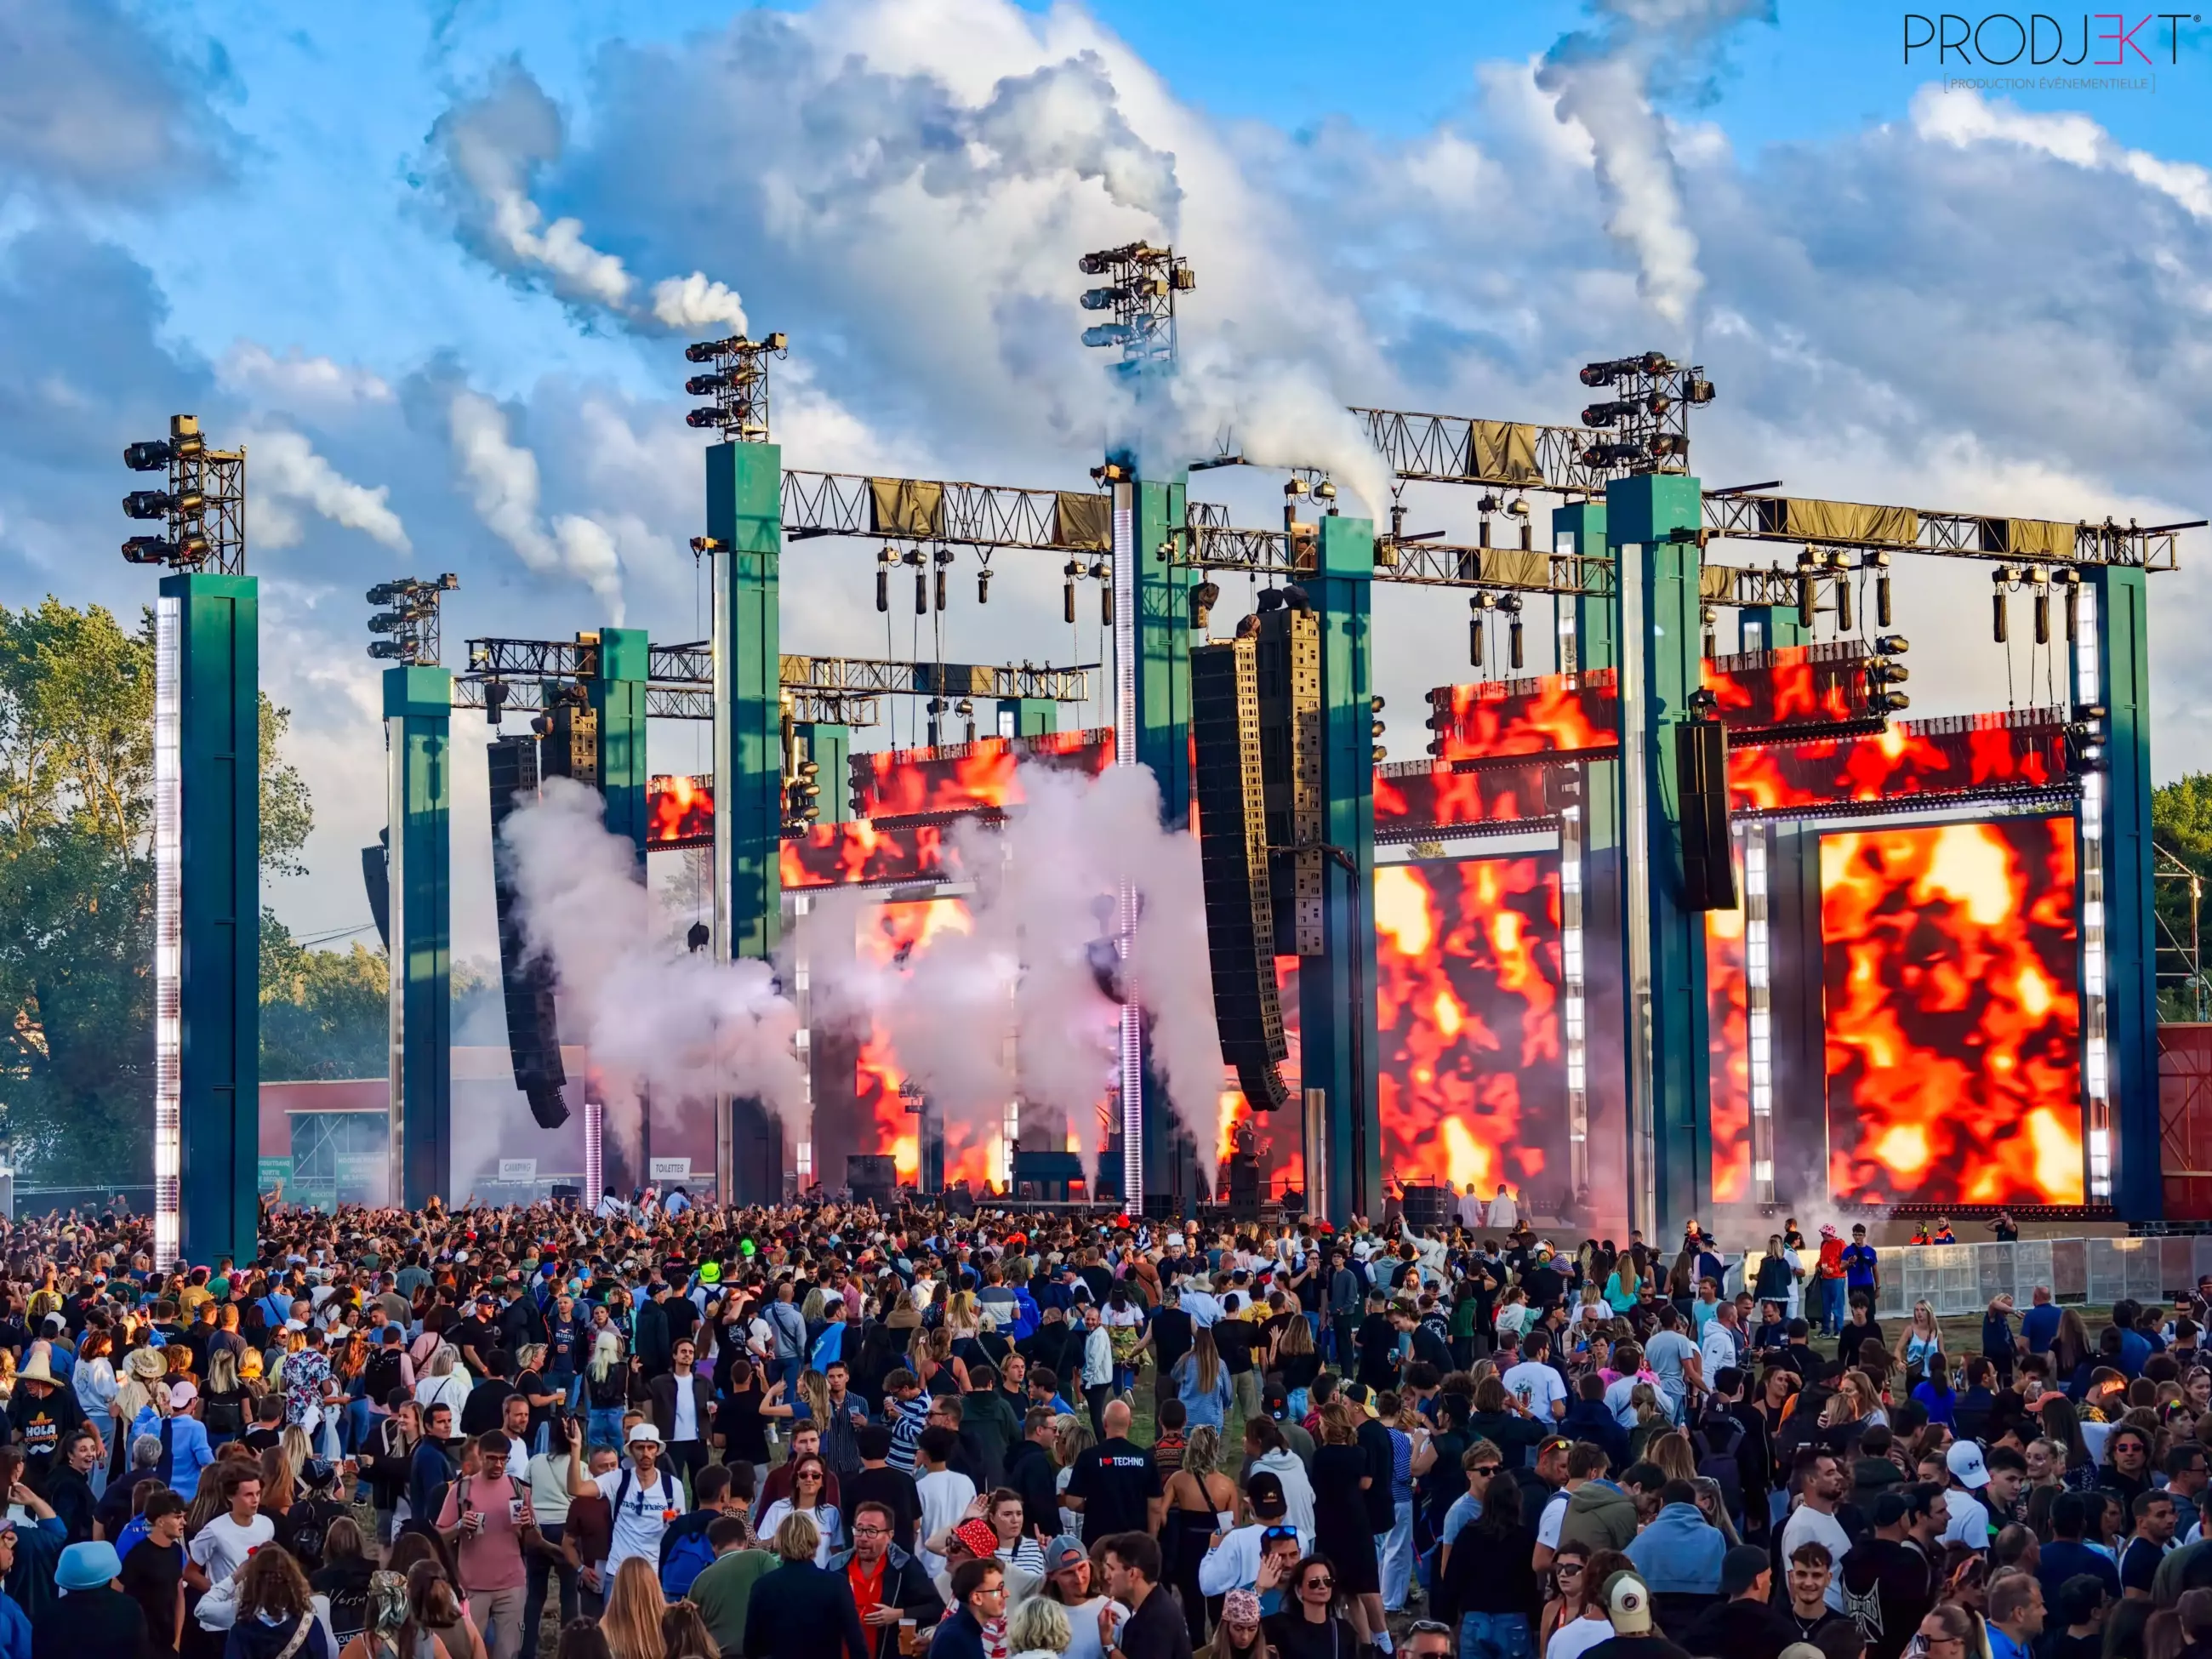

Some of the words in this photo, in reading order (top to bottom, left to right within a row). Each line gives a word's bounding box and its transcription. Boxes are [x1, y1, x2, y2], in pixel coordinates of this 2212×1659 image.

[655, 1164, 684, 1173] TOILETTES
[26, 1424, 56, 1437] HOLA
[1099, 1457, 1103, 1467] I
[1112, 1457, 1144, 1467] TECHNO
